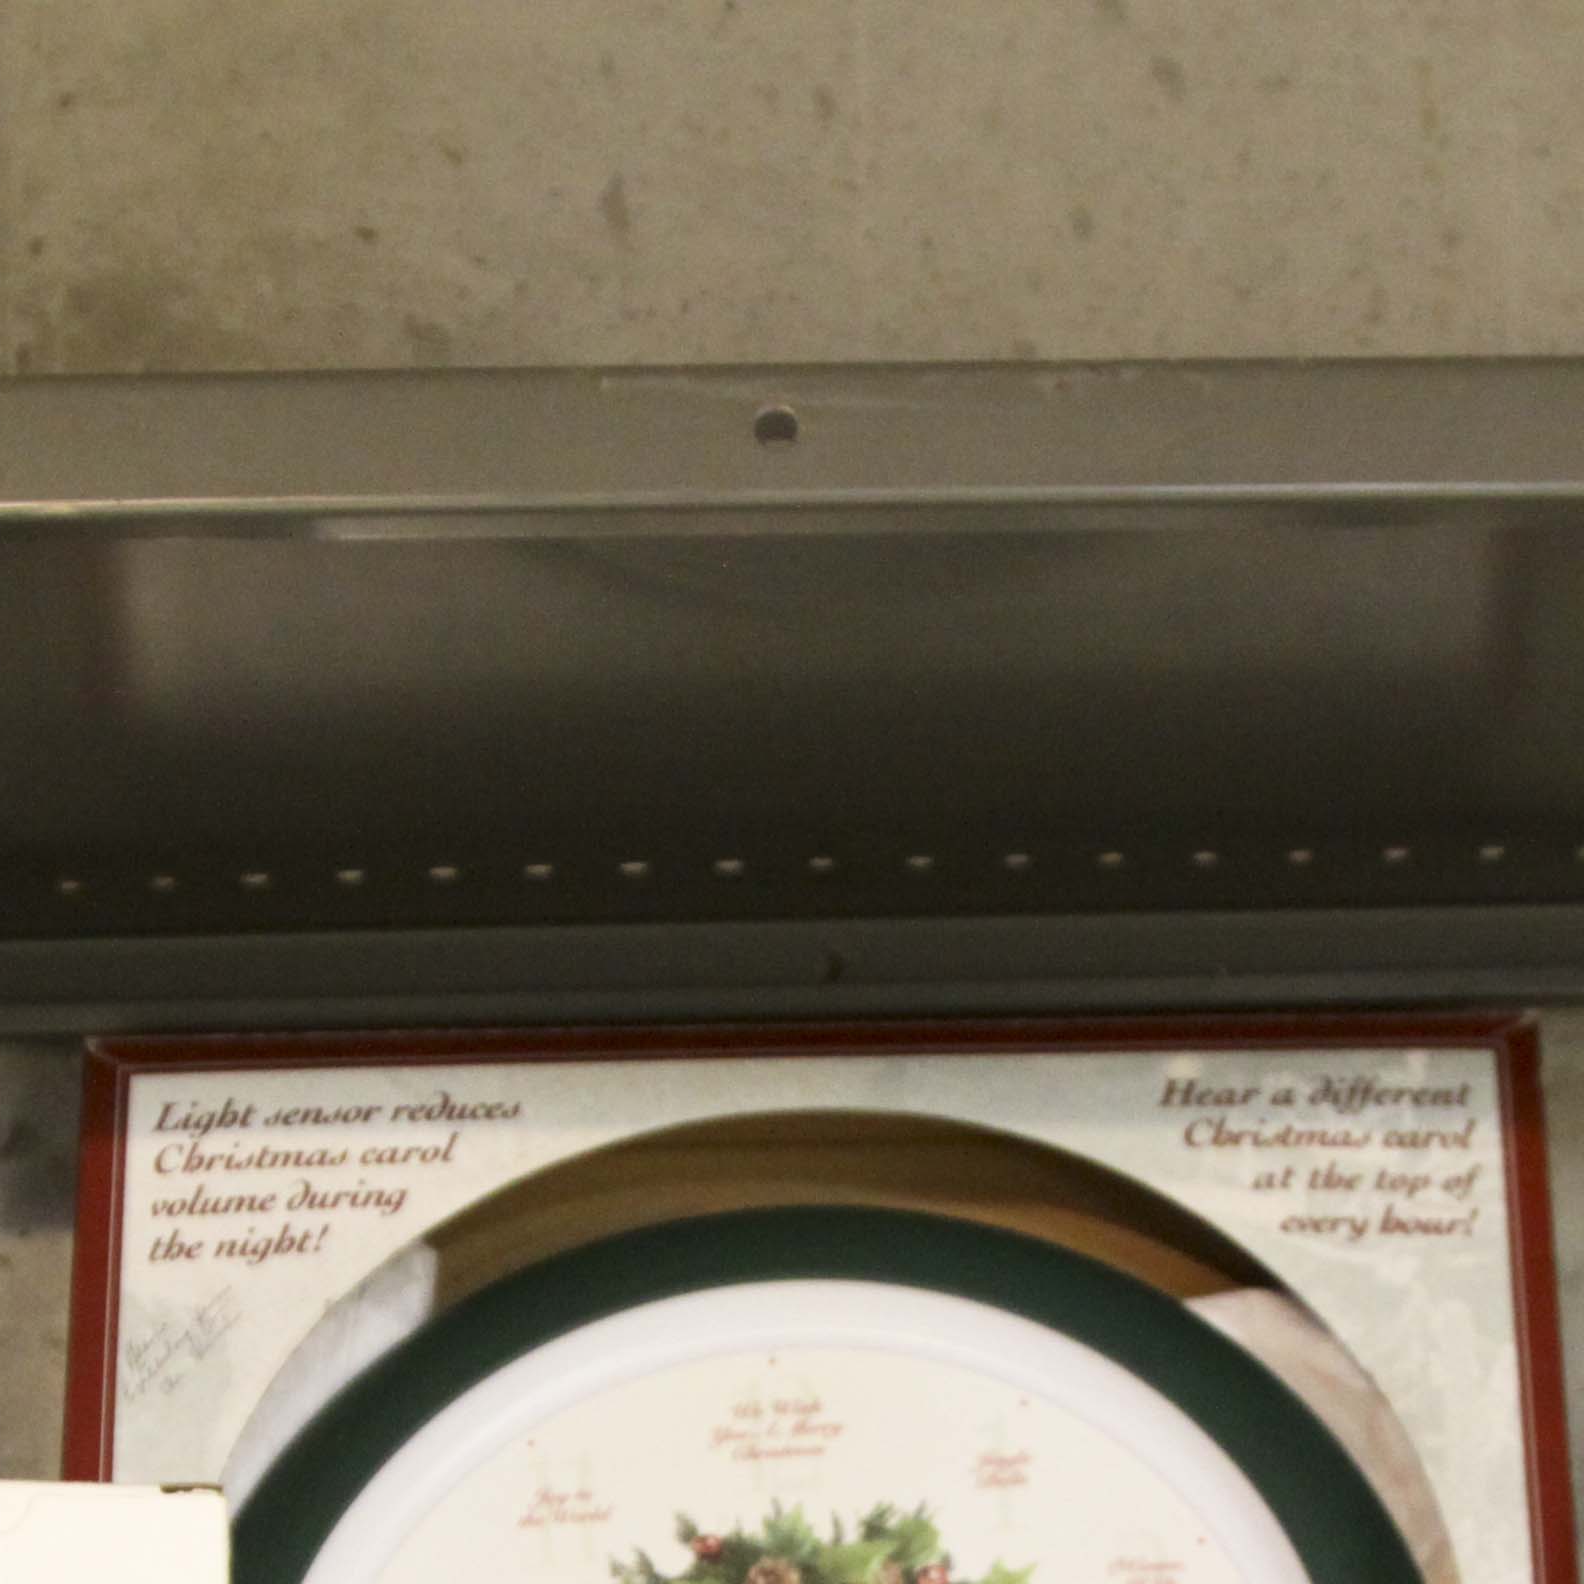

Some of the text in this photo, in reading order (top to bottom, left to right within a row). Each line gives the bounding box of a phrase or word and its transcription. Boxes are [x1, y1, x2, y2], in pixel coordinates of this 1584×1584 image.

[153, 1091, 521, 1135] Light sensor reduces
[1159, 1076, 1470, 1115] Hear a different
[1184, 1118, 1476, 1148] Christmas carol
[154, 1133, 459, 1175] Christmas carol
[151, 1180, 408, 1218] volume during
[1252, 1162, 1482, 1199] at the top of
[1280, 1204, 1478, 1240] every hour!
[149, 1225, 330, 1265] the night!
